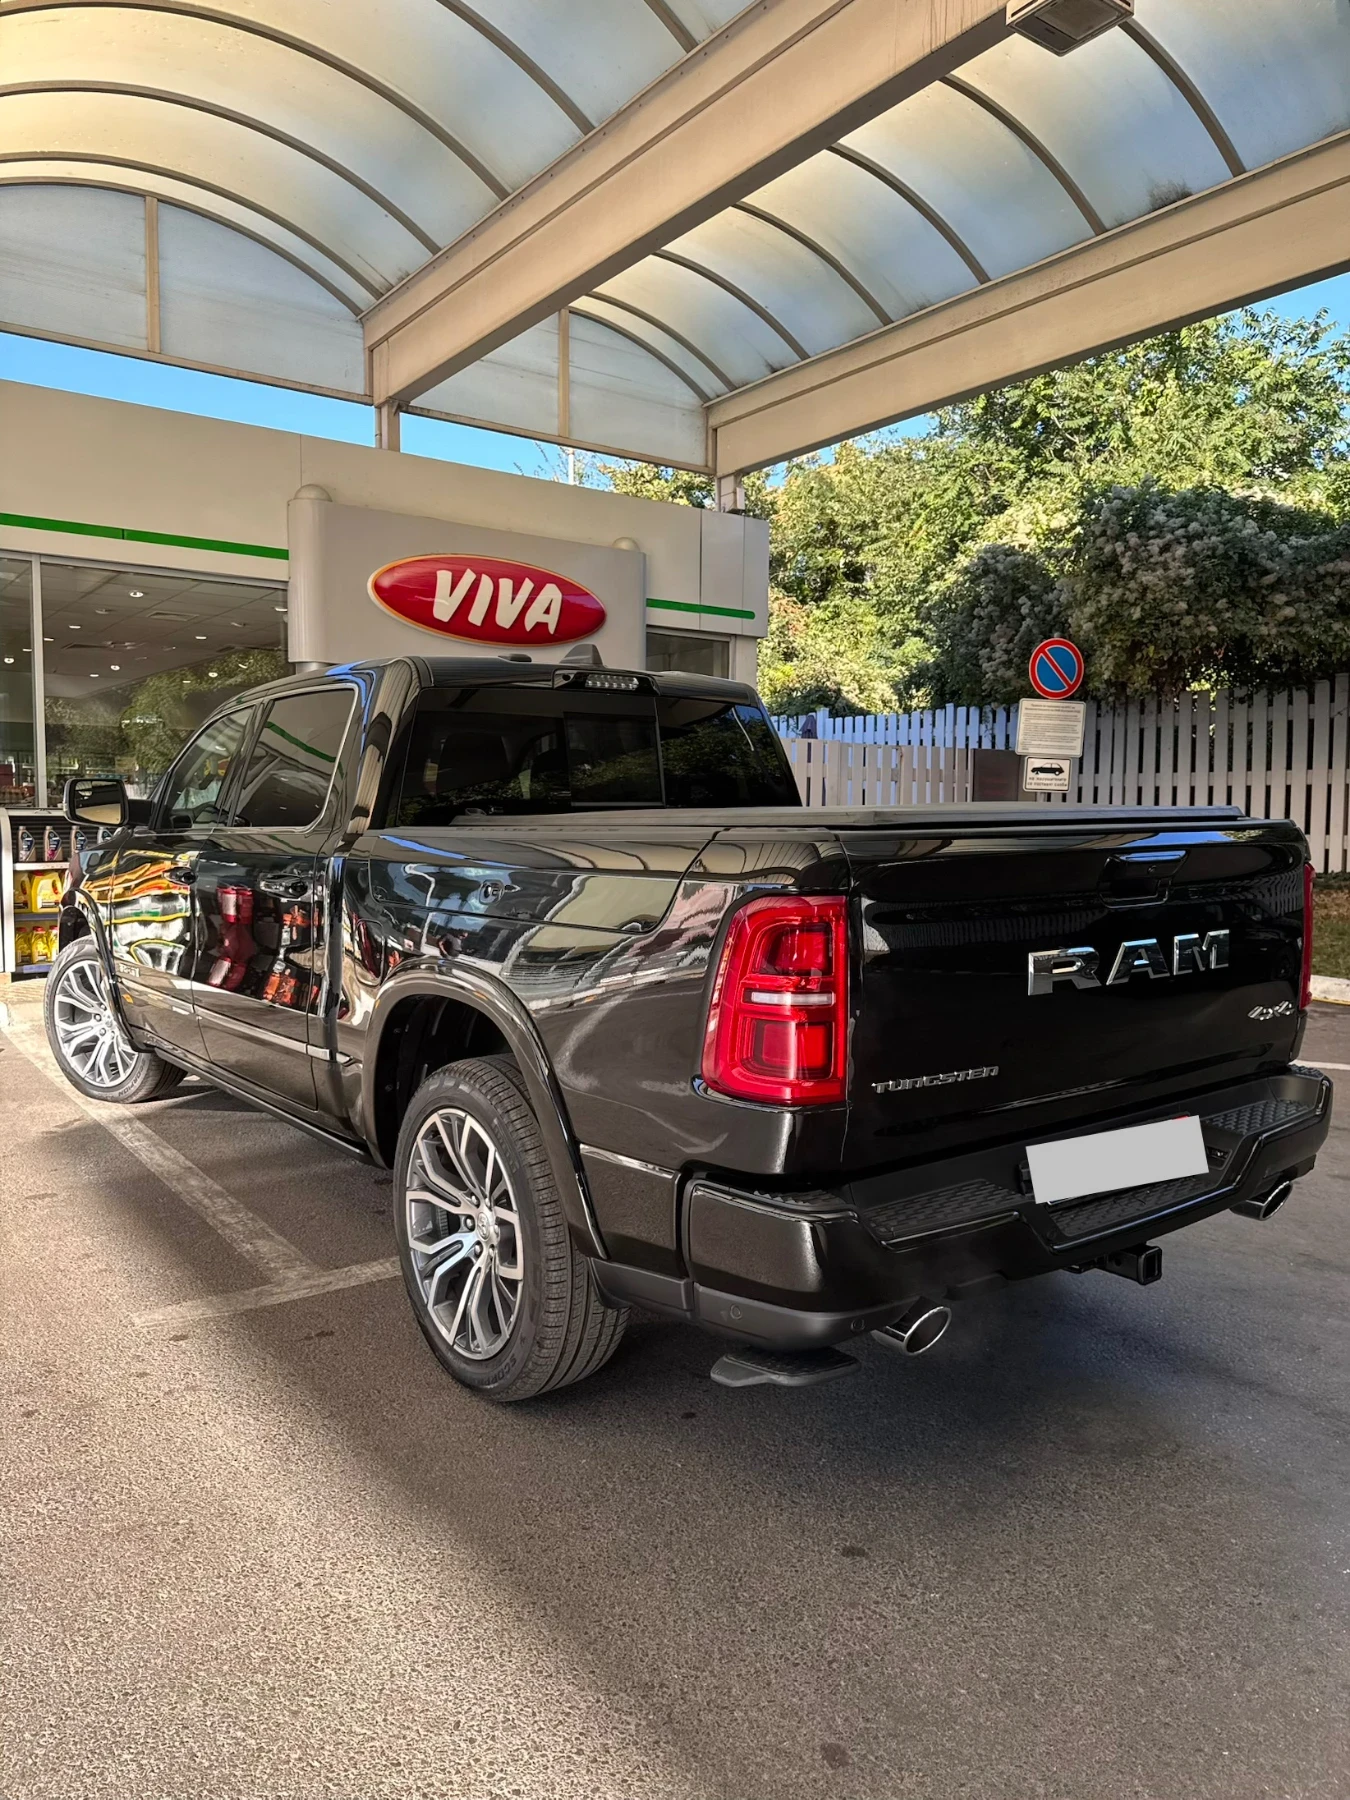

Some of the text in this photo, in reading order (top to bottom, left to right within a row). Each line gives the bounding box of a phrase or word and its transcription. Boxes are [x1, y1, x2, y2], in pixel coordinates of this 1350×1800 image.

[433, 568, 562, 635] VIVA
[1028, 929, 1230, 996] RAM
[871, 1065, 999, 1093] TUNGSTEN
